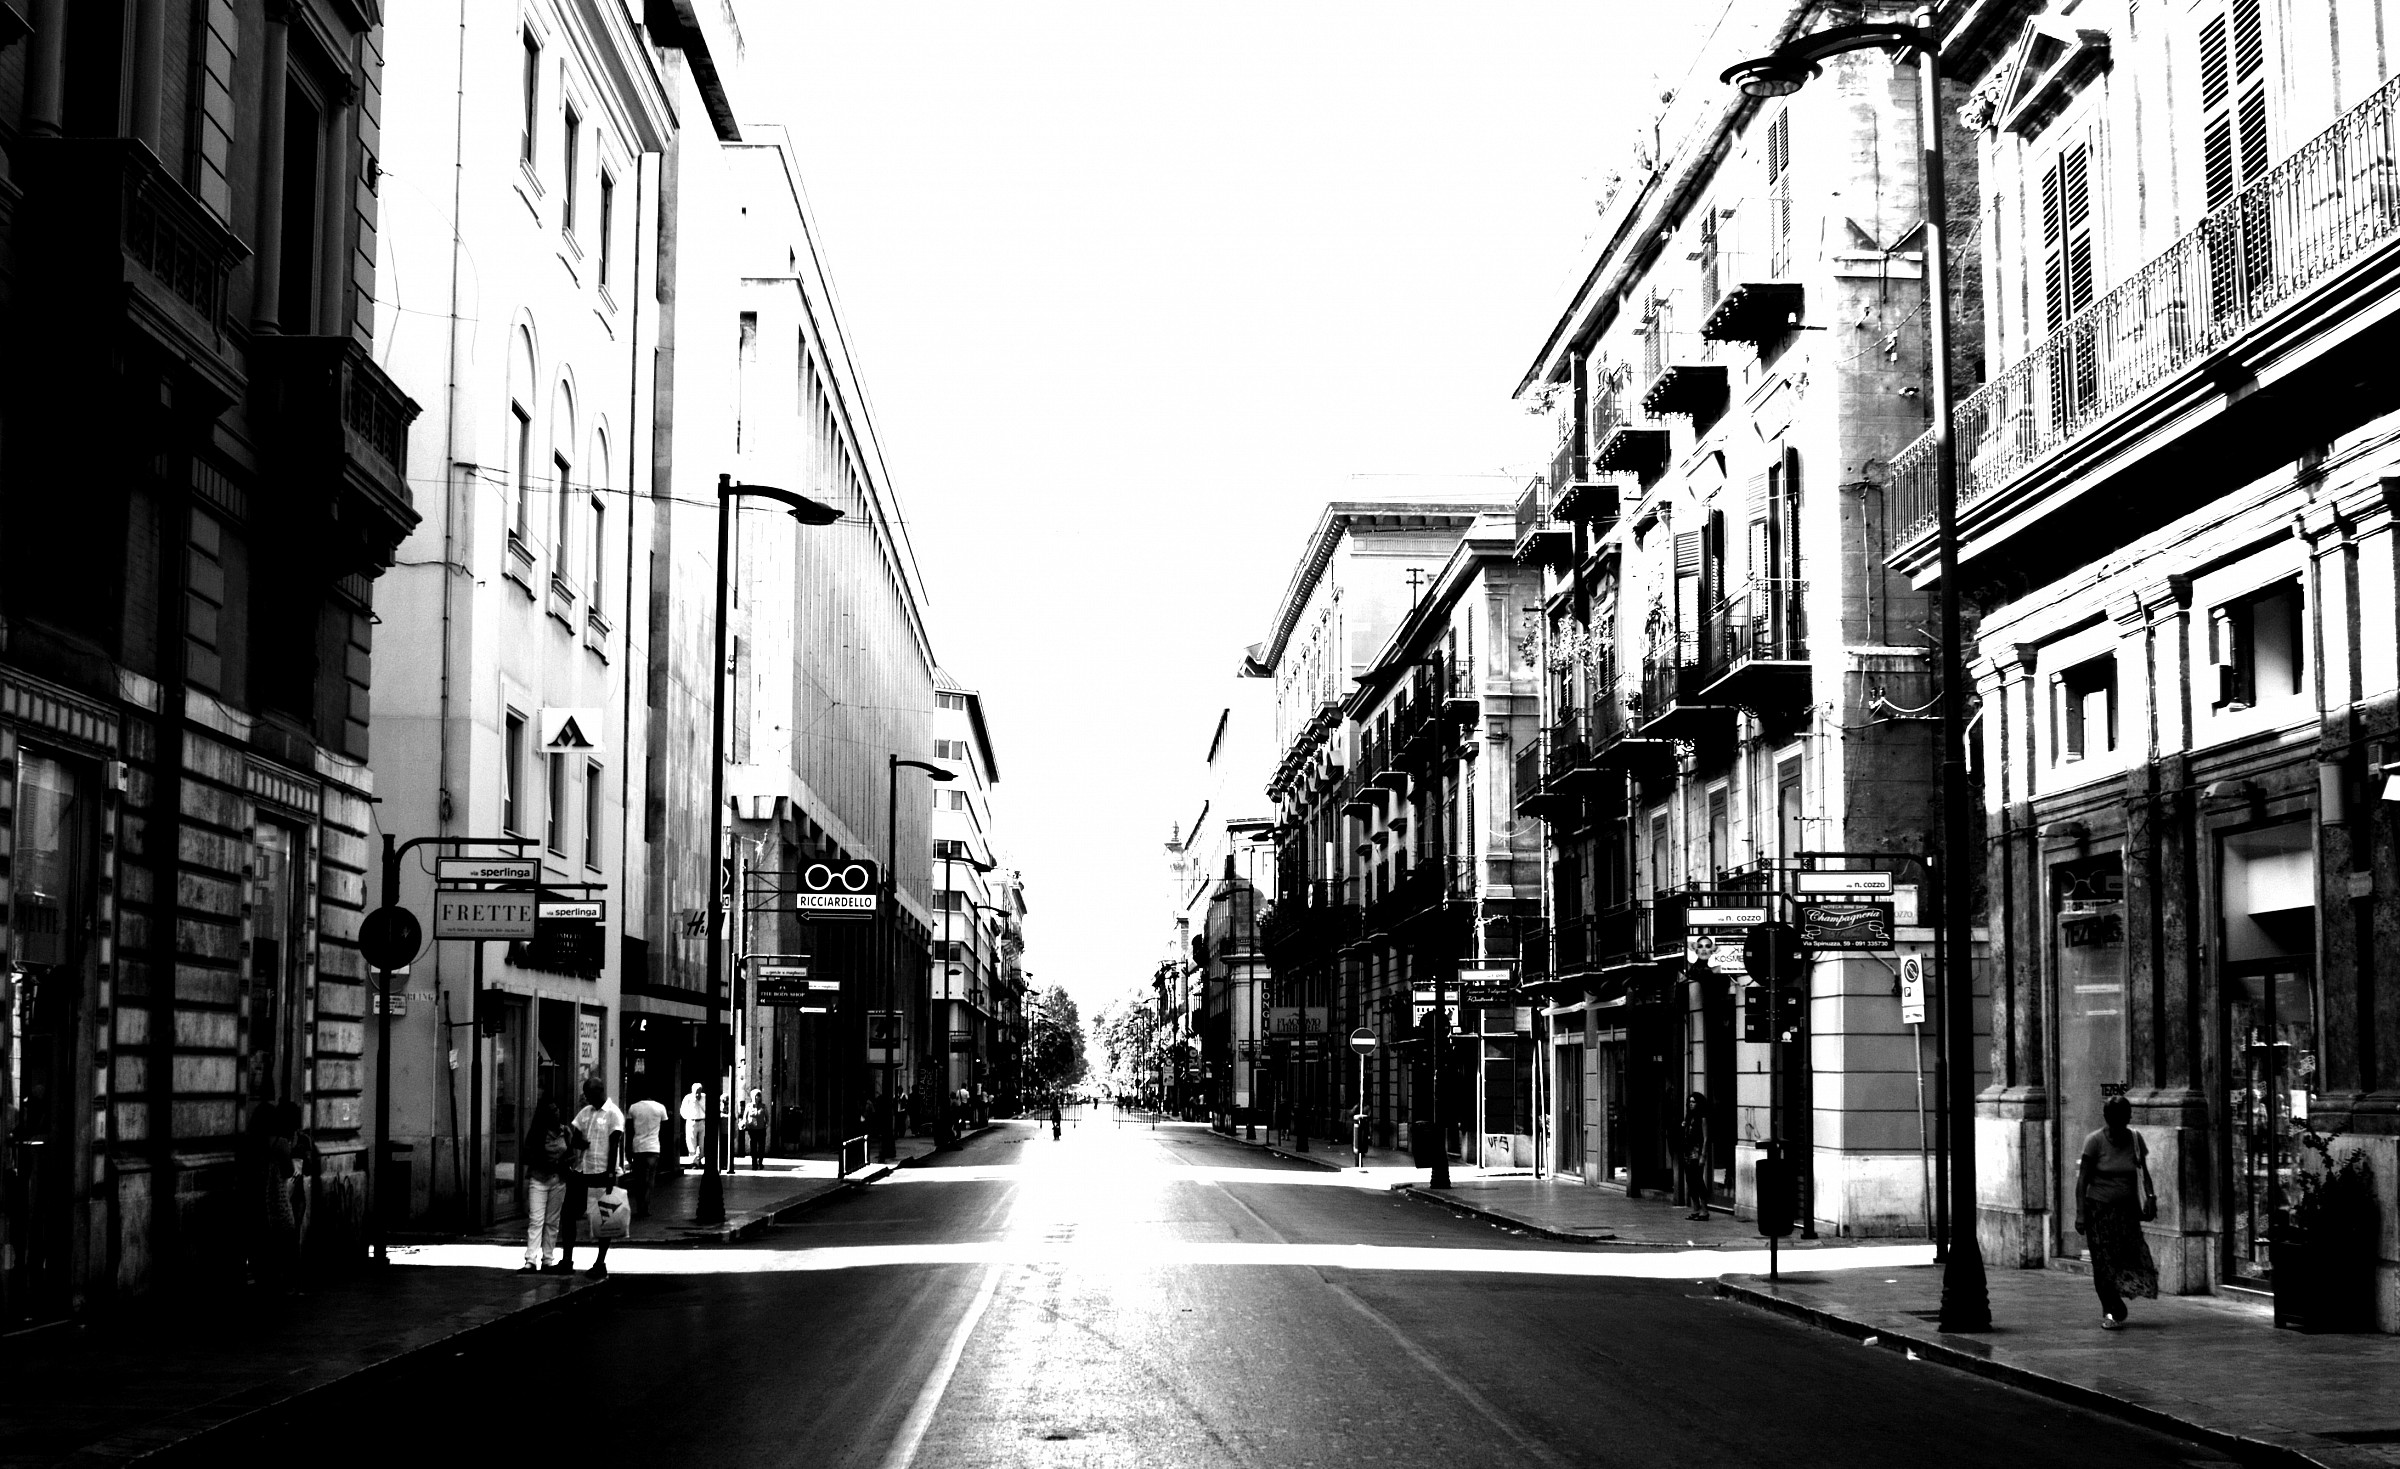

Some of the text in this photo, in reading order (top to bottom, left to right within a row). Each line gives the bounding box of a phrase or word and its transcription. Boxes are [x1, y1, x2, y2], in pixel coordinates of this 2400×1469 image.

[480, 867, 530, 878] sperlinga
[800, 896, 872, 908] RICCIARDELLO
[443, 904, 531, 921] FRETTE
[555, 908, 597, 917] sperlinga
[1807, 909, 1880, 927] Champagneria
[1714, 955, 1744, 963] KOSME
